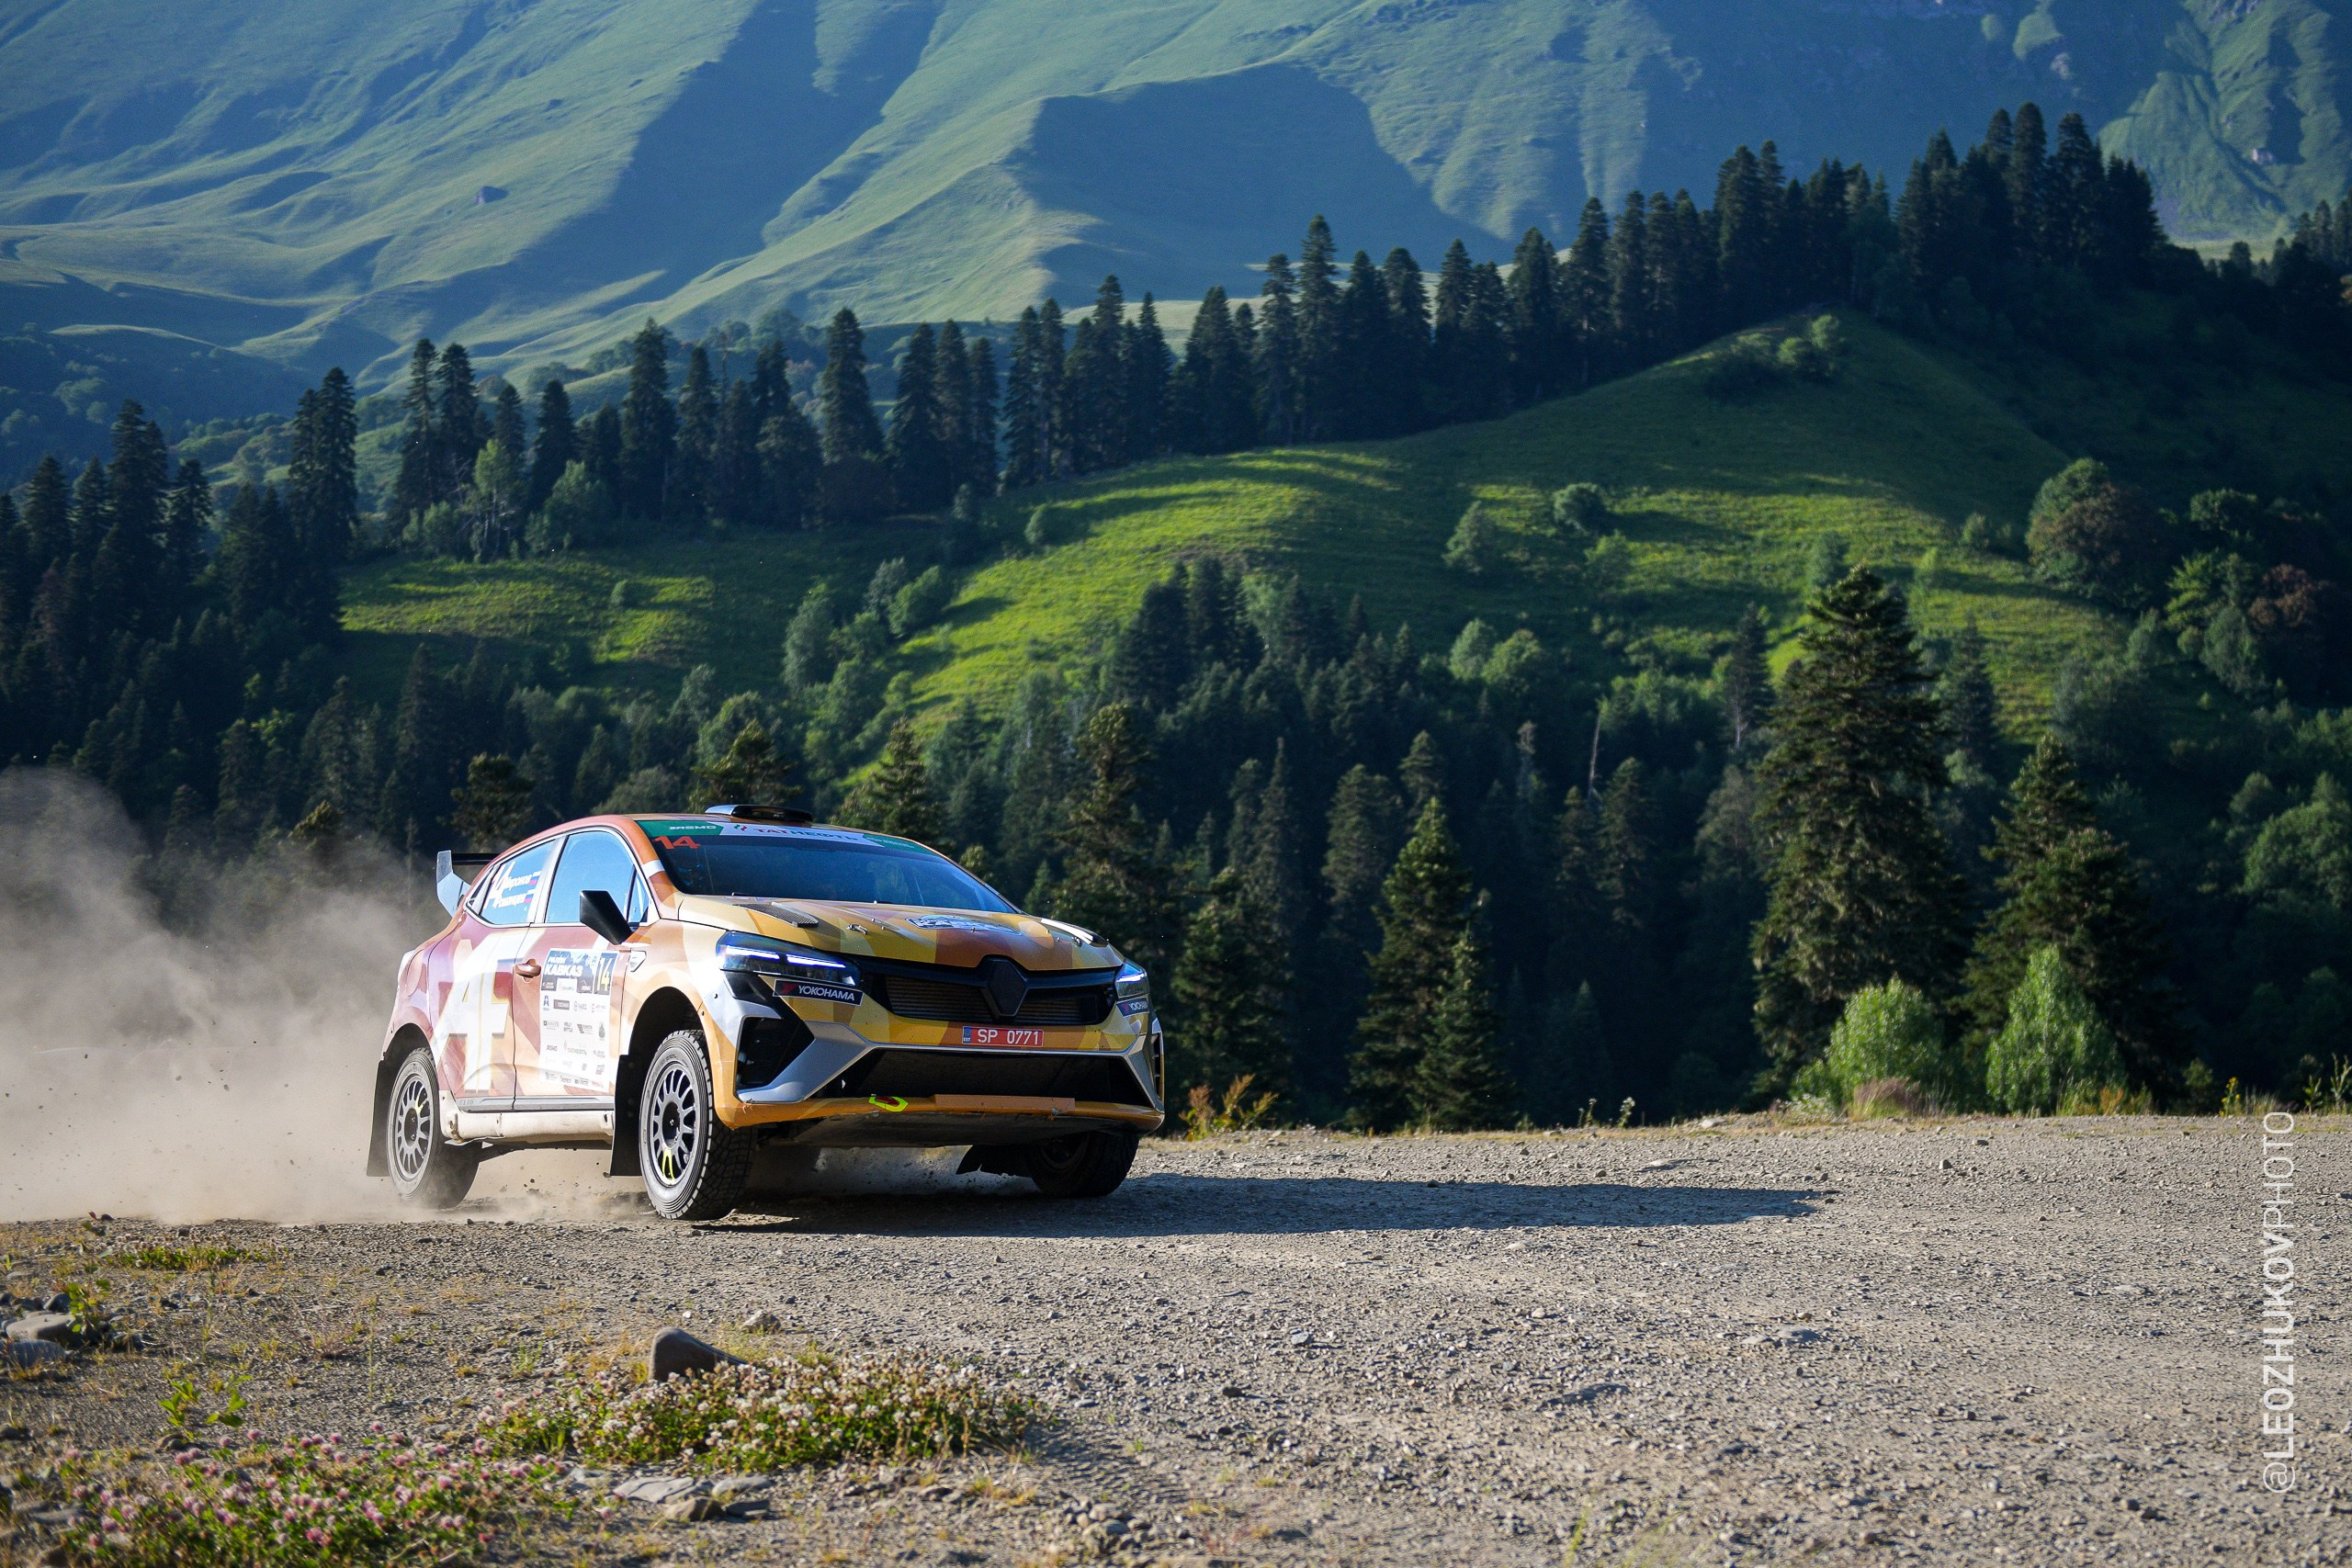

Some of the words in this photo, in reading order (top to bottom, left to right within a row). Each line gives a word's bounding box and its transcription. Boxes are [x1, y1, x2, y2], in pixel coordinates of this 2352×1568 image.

[652, 835, 701, 850] 14
[753, 829, 859, 841] ТАТНЕФТЬ
[544, 964, 583, 977] КАВКАЗ
[596, 957, 613, 992] 14
[798, 985, 855, 1001] YOKOHAMA
[978, 1029, 999, 1043] SP
[1007, 1030, 1039, 1045] 0771
